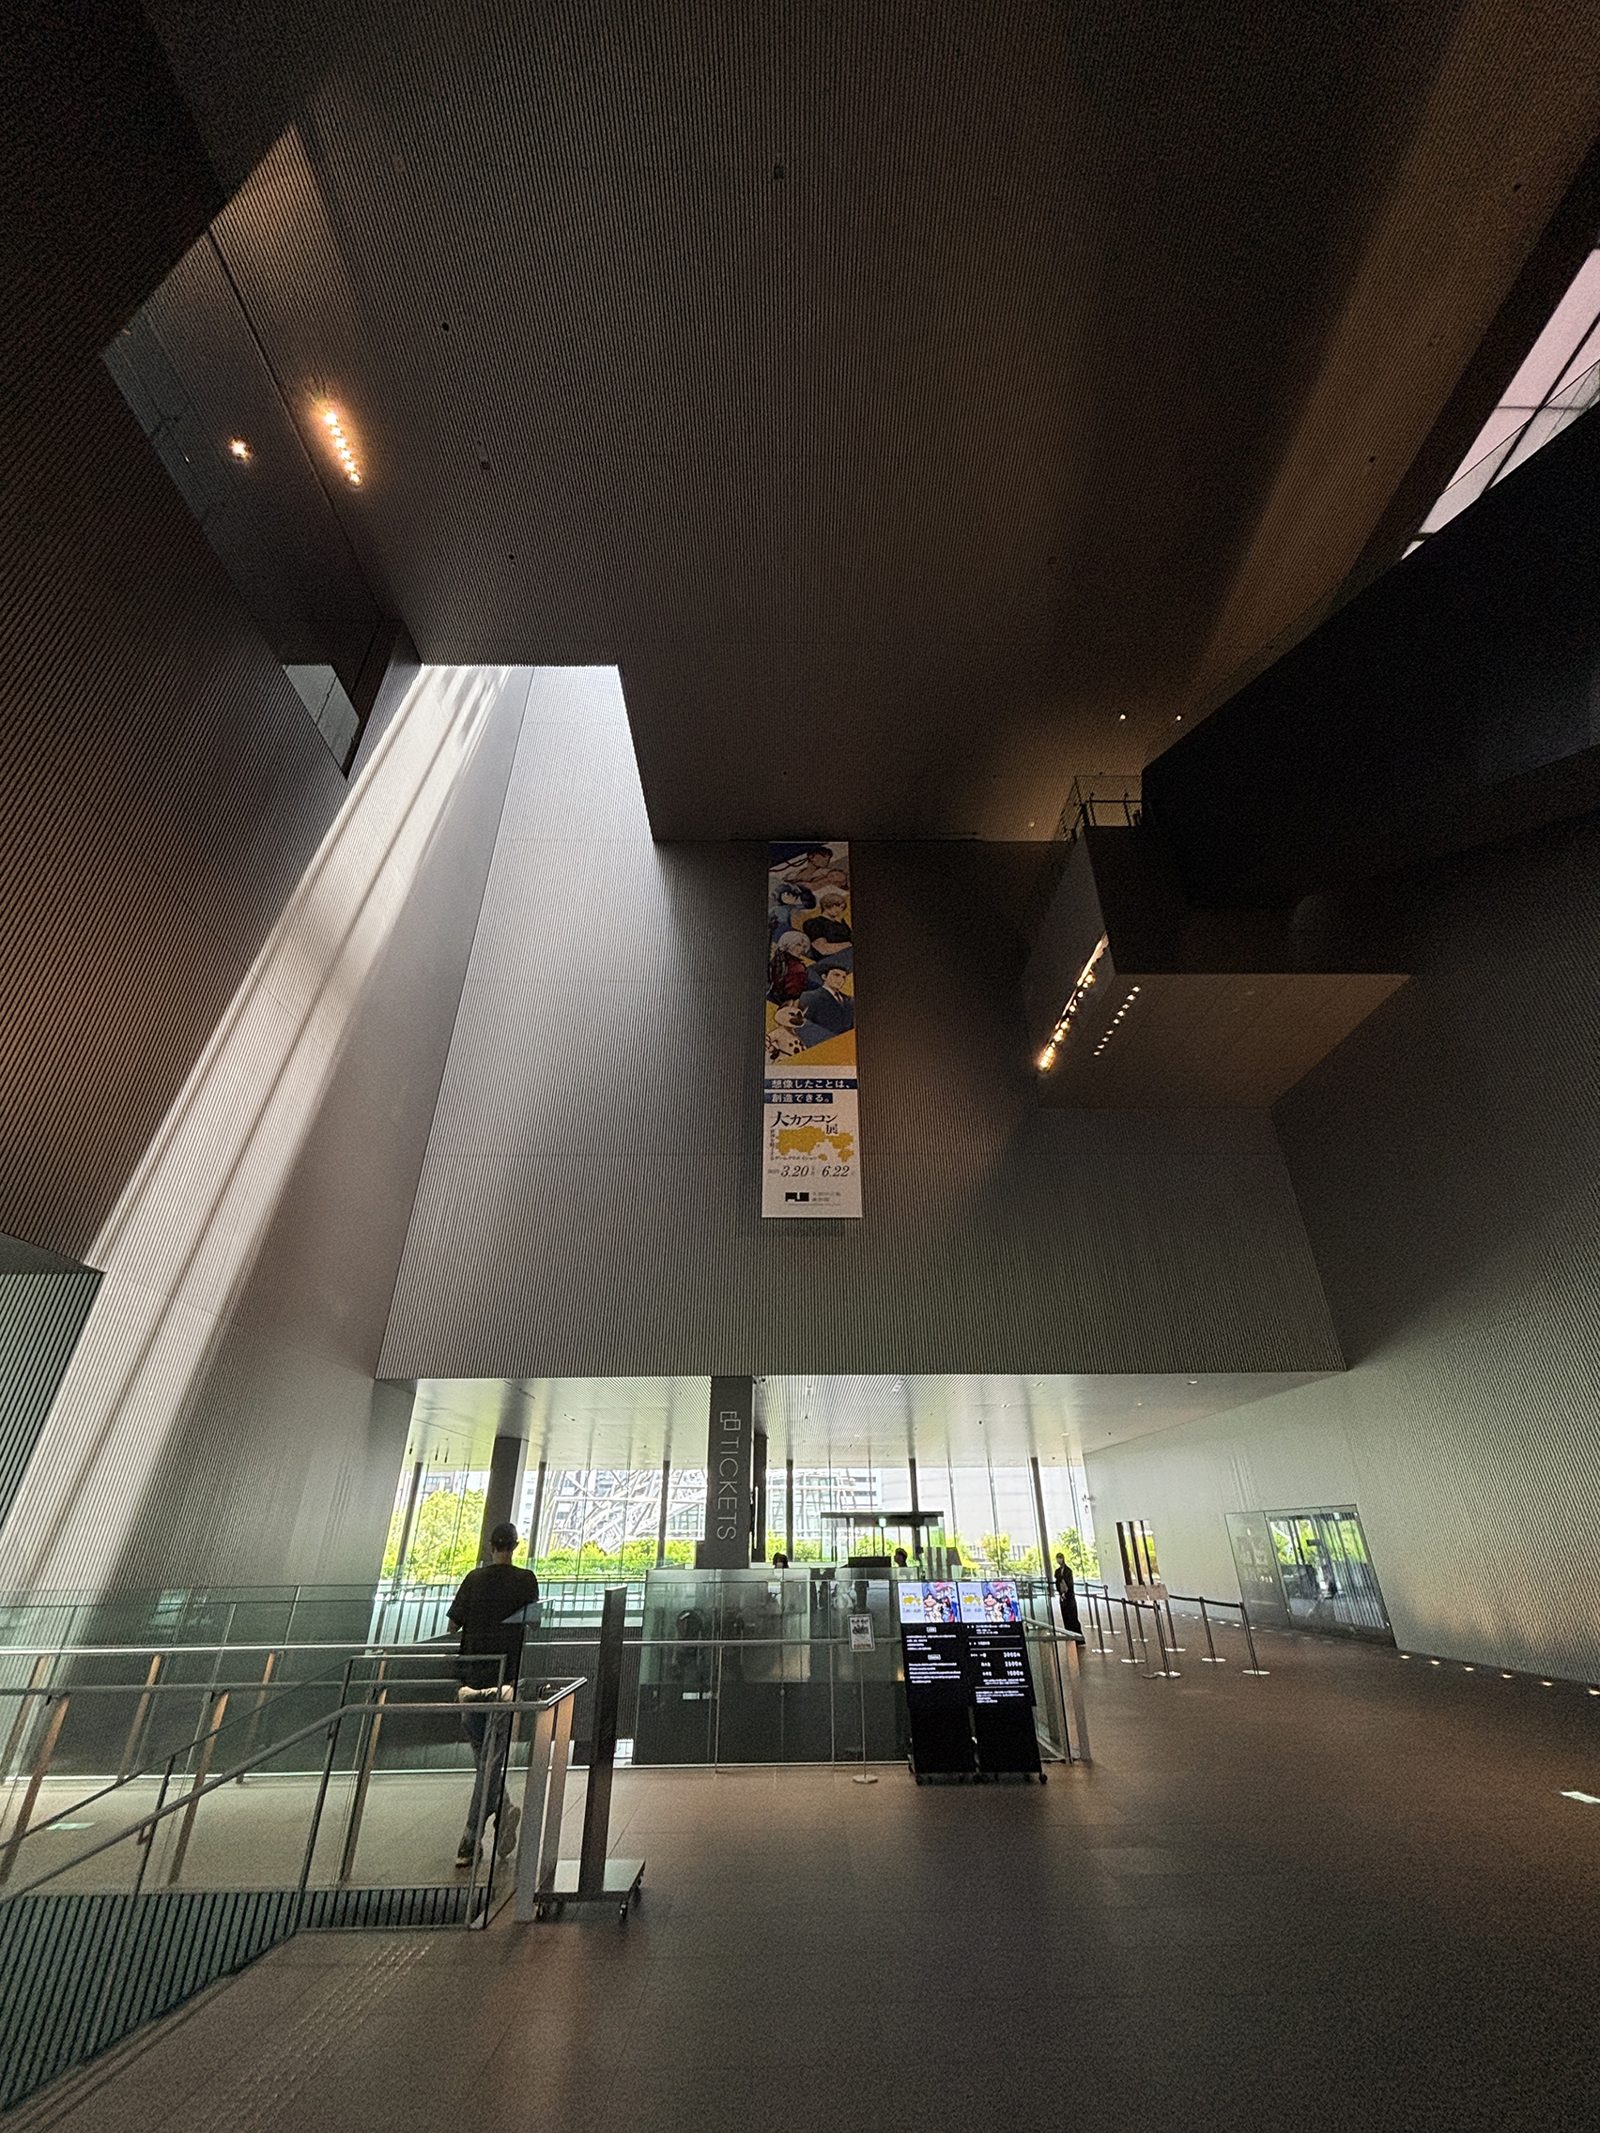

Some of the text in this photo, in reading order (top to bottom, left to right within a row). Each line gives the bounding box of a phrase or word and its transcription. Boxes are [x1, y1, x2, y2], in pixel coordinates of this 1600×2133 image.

[771, 1080, 850, 1089] 想像したことは、
[771, 1094, 830, 1103] 創造できる。
[780, 1165, 810, 1177] 3.20
[821, 1165, 850, 1177] 6.22
[717, 1437, 739, 1540] TICKETS
